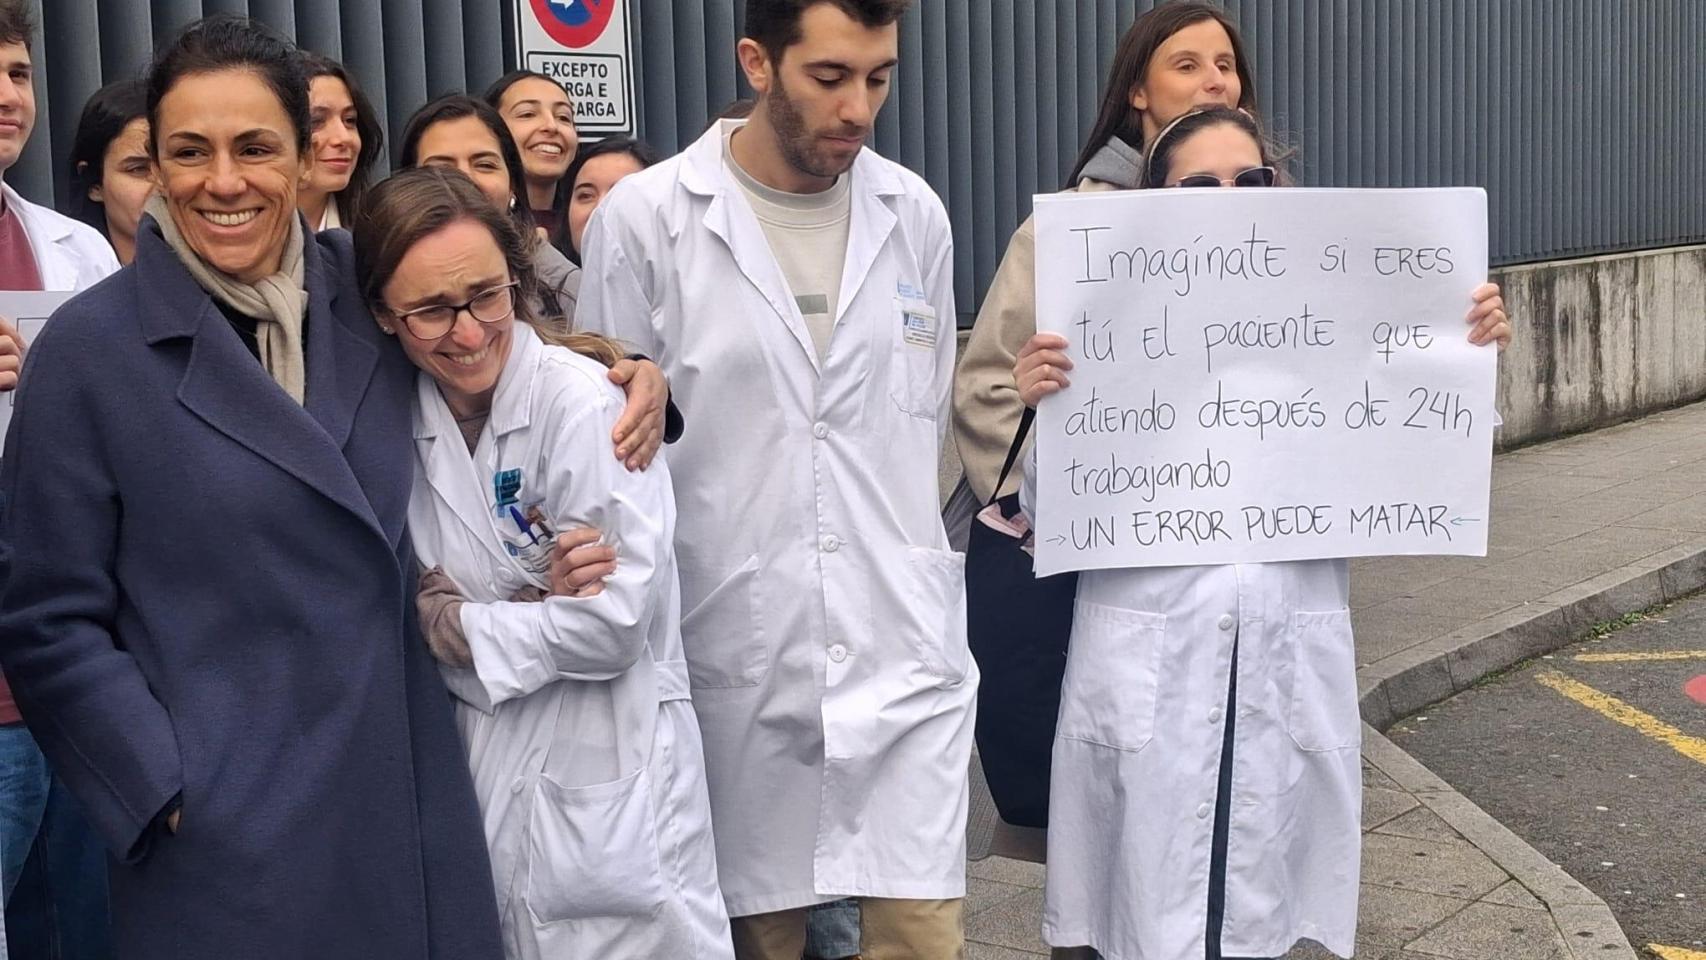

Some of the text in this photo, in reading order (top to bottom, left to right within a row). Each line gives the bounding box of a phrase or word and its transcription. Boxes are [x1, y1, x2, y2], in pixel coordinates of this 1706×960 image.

[542, 61, 608, 78] EXCEPTO
[598, 83, 608, 98] E
[1070, 222, 1287, 297] Imagínate
[1319, 237, 1348, 274] si
[1075, 310, 1116, 363] tú
[1203, 303, 1335, 374] paciente
[1065, 386, 1176, 436] atiendo
[1402, 386, 1473, 438] 24h
[1063, 447, 1231, 503] trabajando
[1070, 502, 1451, 551] UN ERROR PUEDE MATAR
